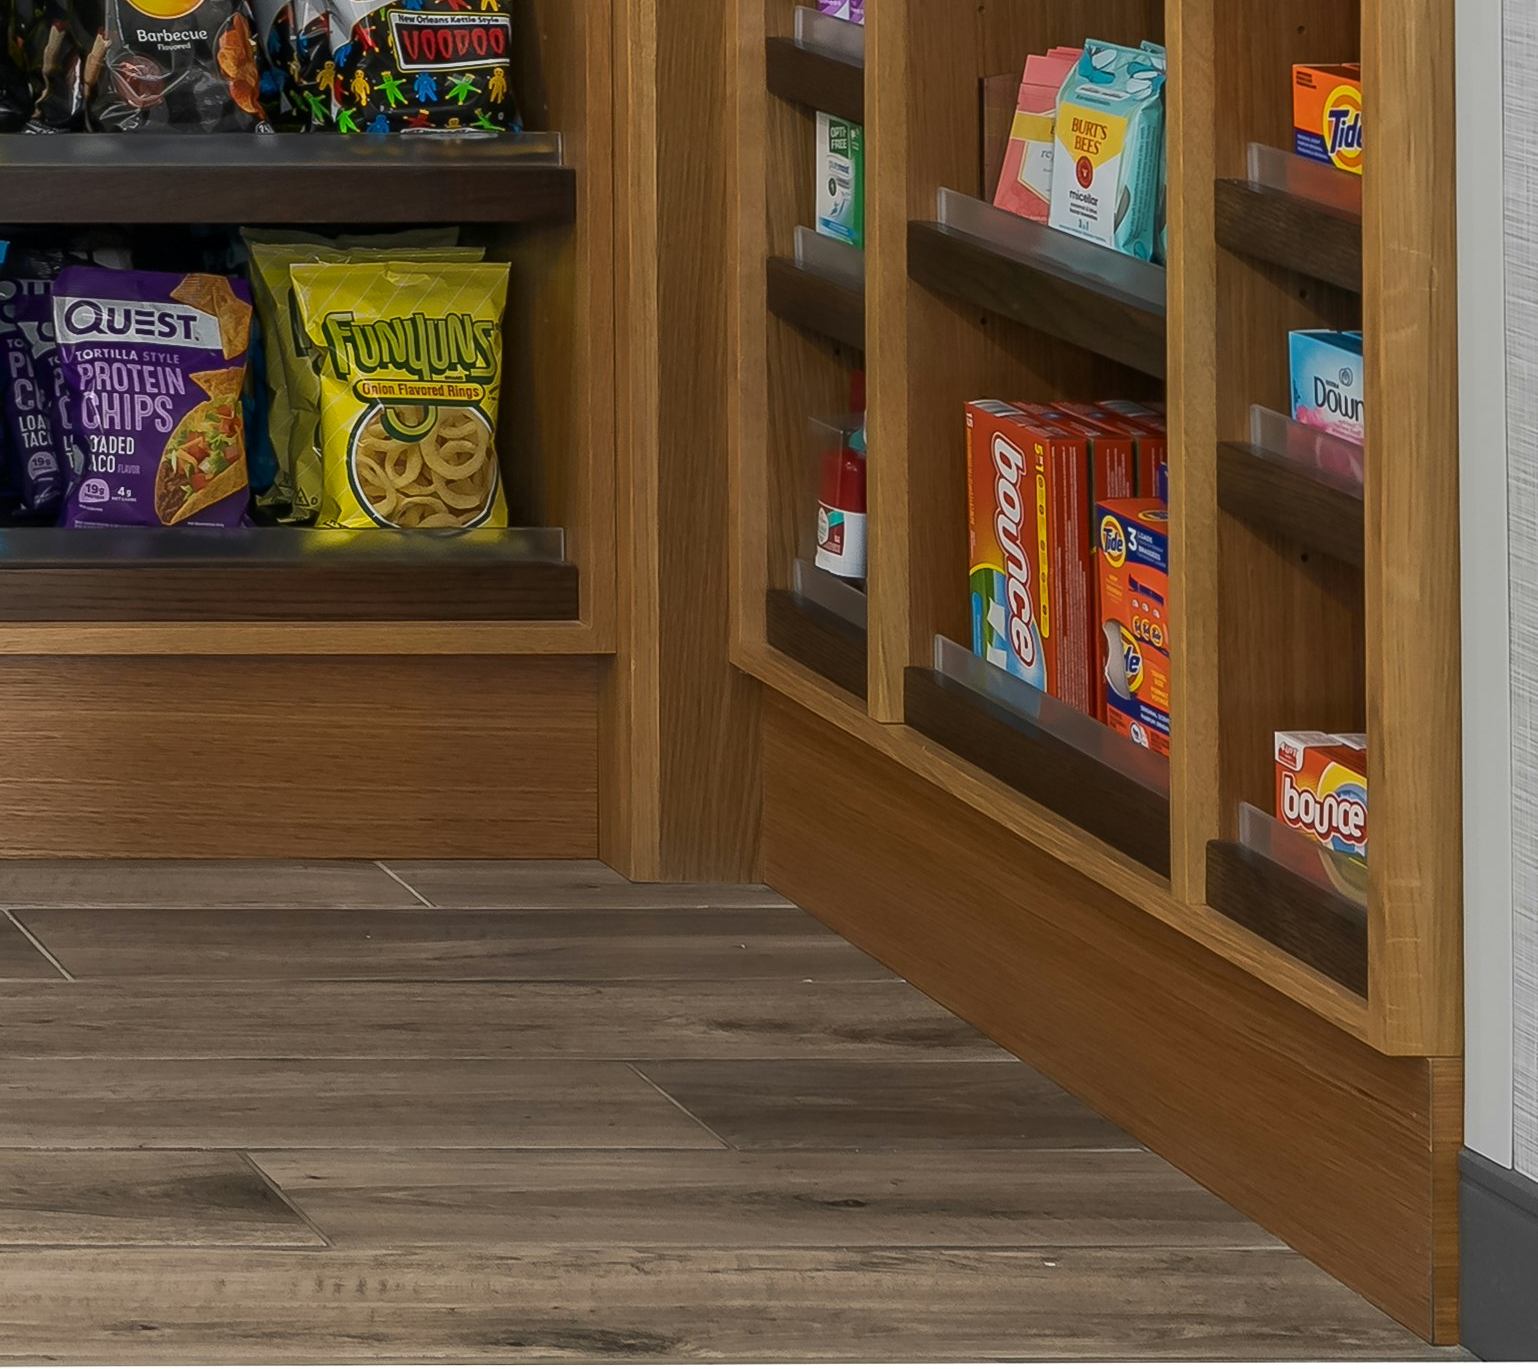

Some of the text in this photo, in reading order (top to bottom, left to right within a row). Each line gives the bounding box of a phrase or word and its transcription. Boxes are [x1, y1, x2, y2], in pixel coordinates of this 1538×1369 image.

[137, 27, 208, 43] Barbecue
[399, 26, 507, 64] VOODOO
[1070, 117, 1108, 142] BURT'S
[1074, 133, 1102, 155] BEES
[325, 310, 497, 384] FUNYUNS
[78, 362, 186, 396] PROTEIN
[362, 383, 480, 402] Onion Flavored Rings
[80, 394, 174, 433] CHIPS
[992, 432, 1035, 665] bounce
[1102, 527, 1124, 556] Tide
